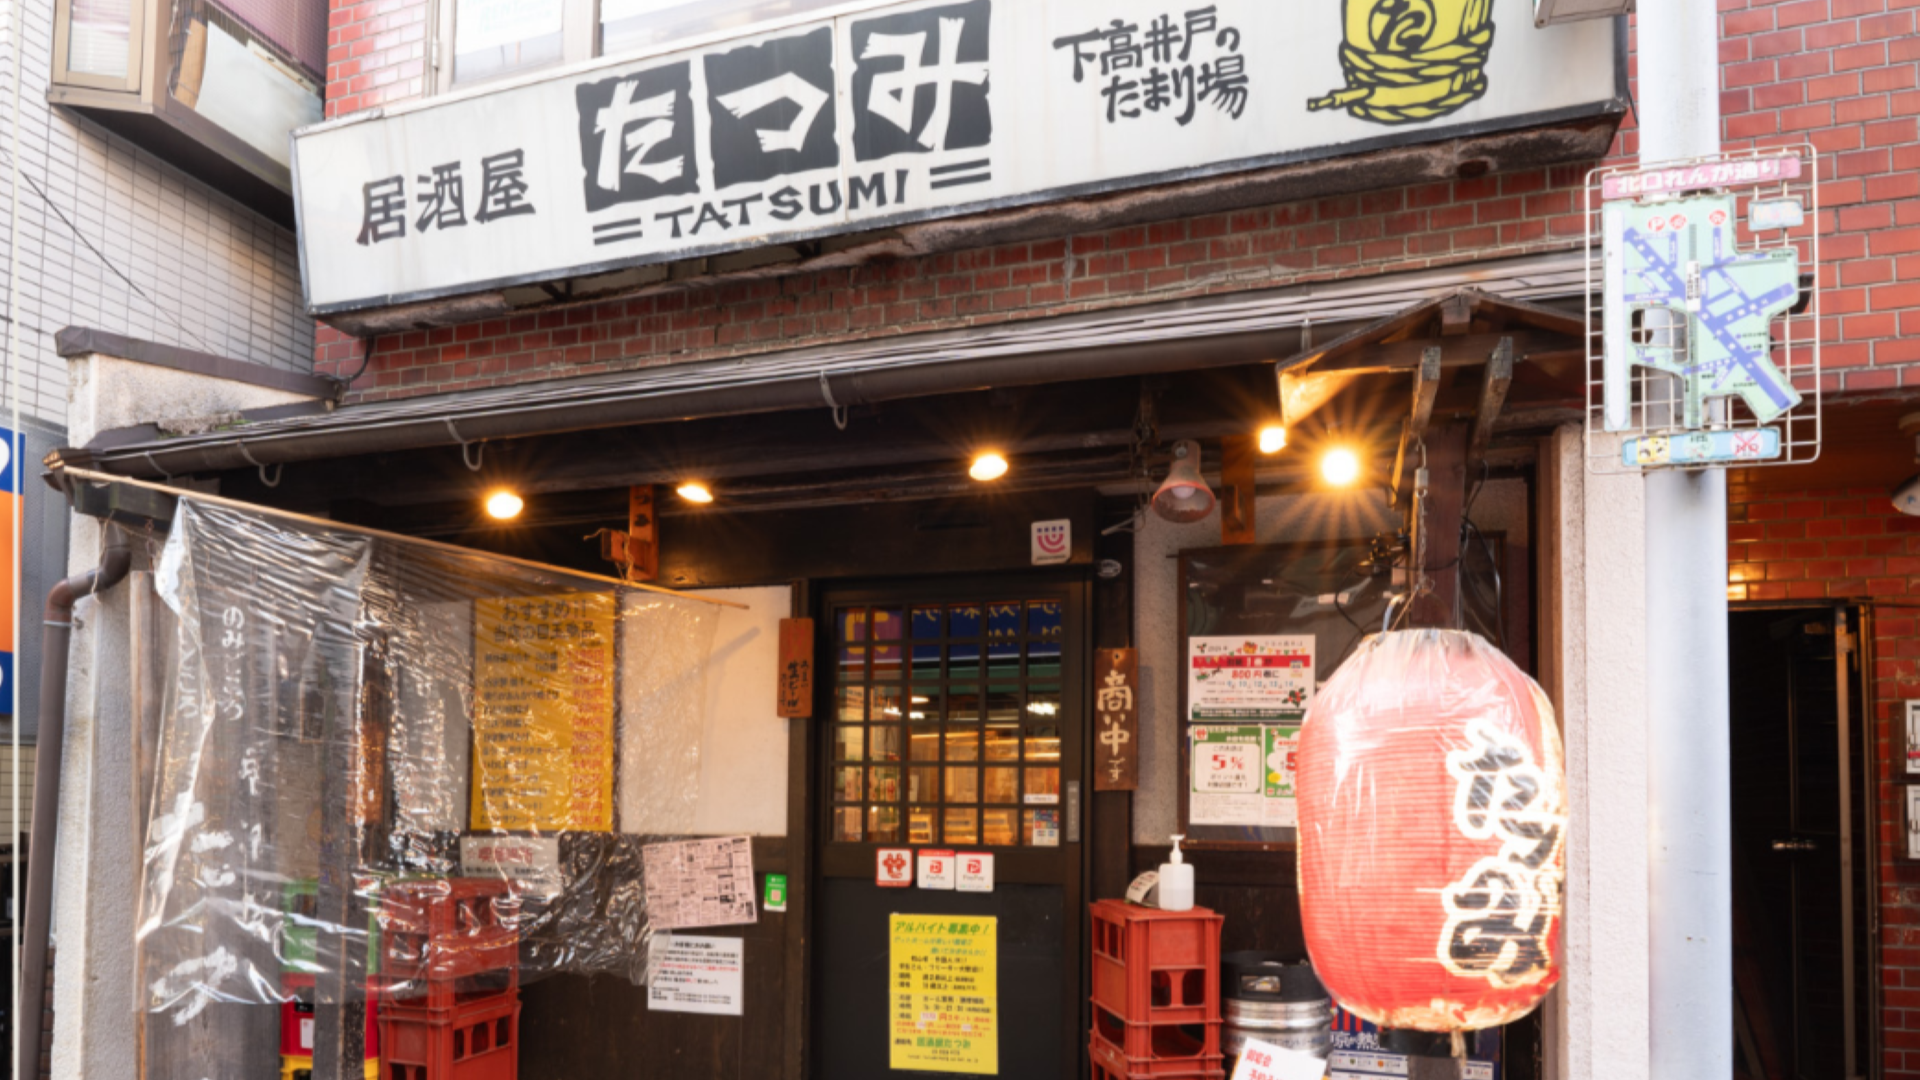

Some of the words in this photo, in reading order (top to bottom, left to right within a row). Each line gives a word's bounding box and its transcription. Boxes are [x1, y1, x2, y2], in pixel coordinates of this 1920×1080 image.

[1053, 6, 1240, 82] 下高井戸の
[594, 17, 990, 191] たつみ
[1101, 54, 1249, 125] たまり場
[356, 148, 536, 246] 居酒屋
[655, 169, 910, 238] TATSUMI
[1617, 158, 1780, 194] 北口れんが通り
[1097, 669, 1134, 784] 商い中です
